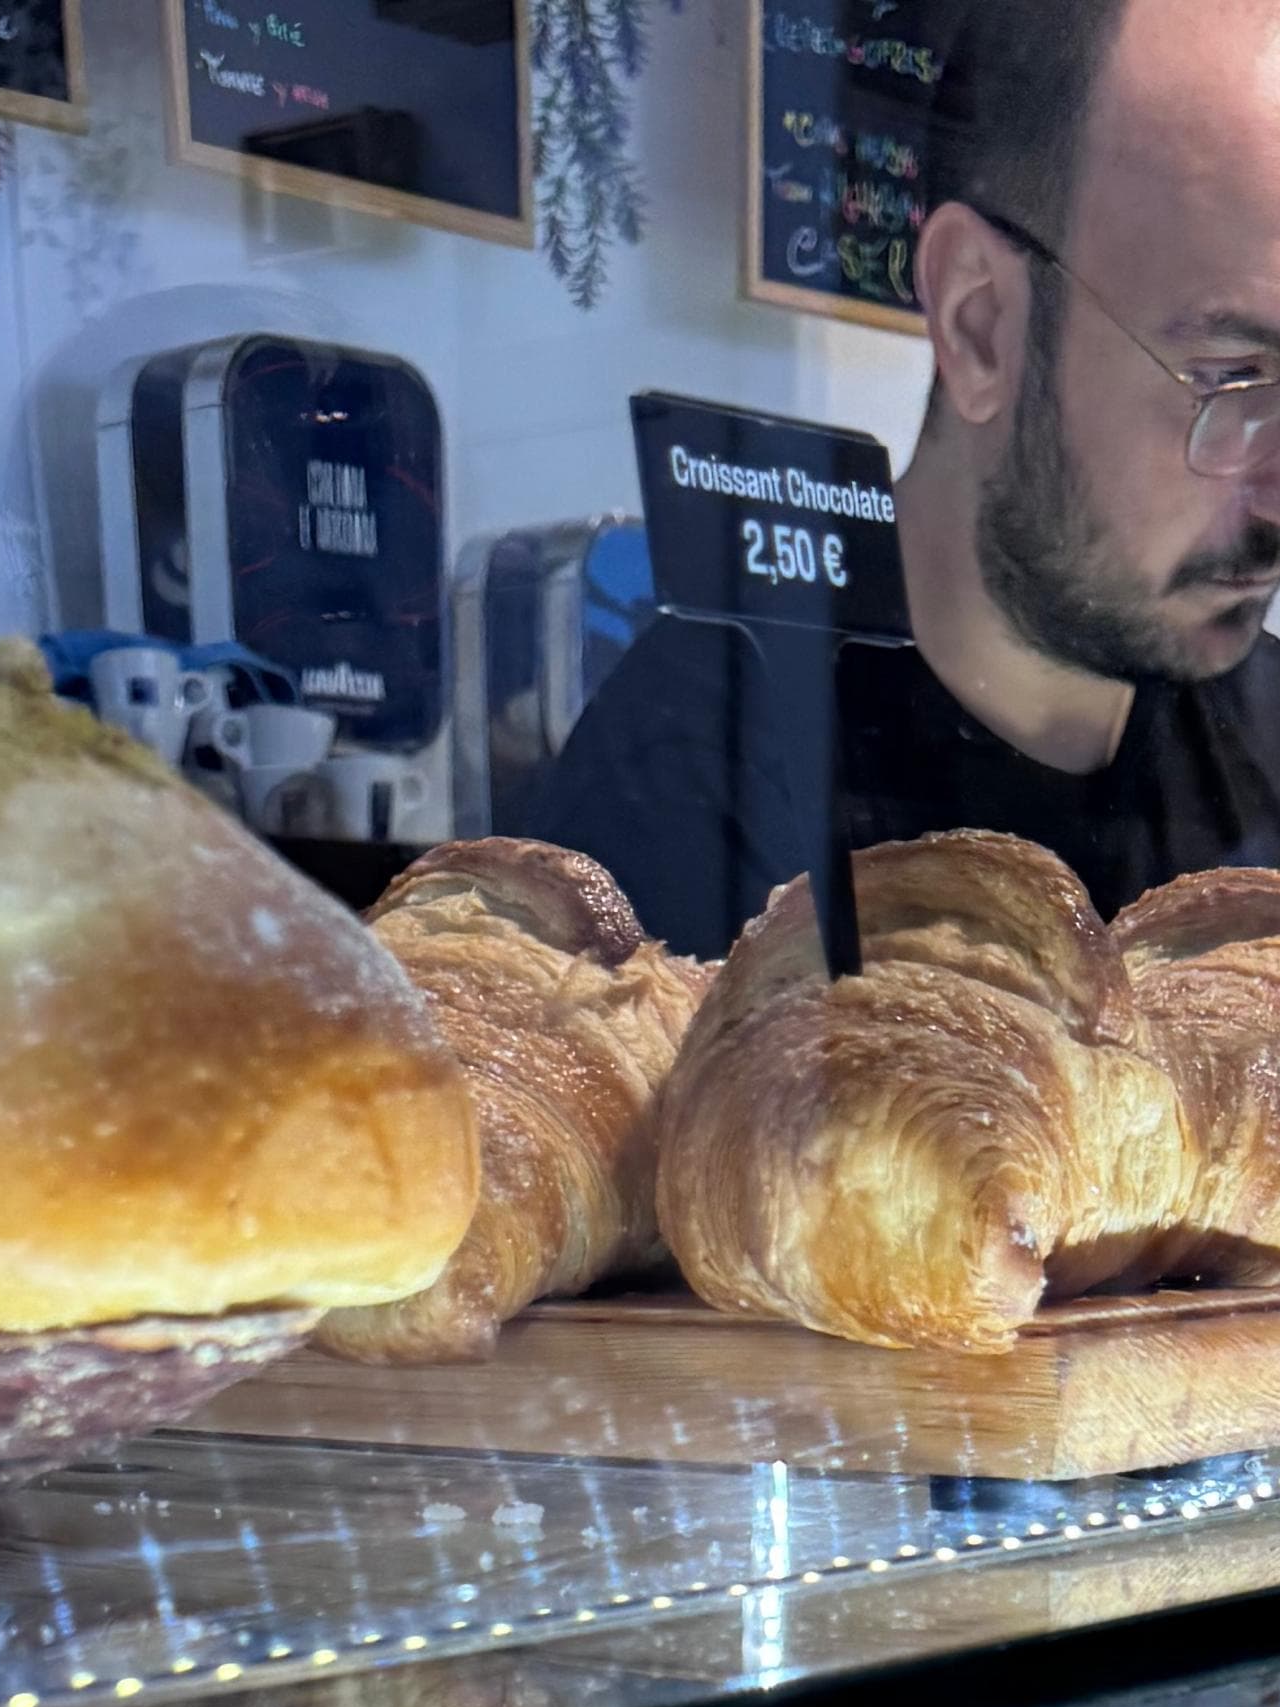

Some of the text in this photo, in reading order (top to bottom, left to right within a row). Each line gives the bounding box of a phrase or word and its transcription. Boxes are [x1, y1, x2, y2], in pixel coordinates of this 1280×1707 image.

[669, 444, 896, 524] Croissant Chocolate
[742, 519, 848, 588] 2,50 €
